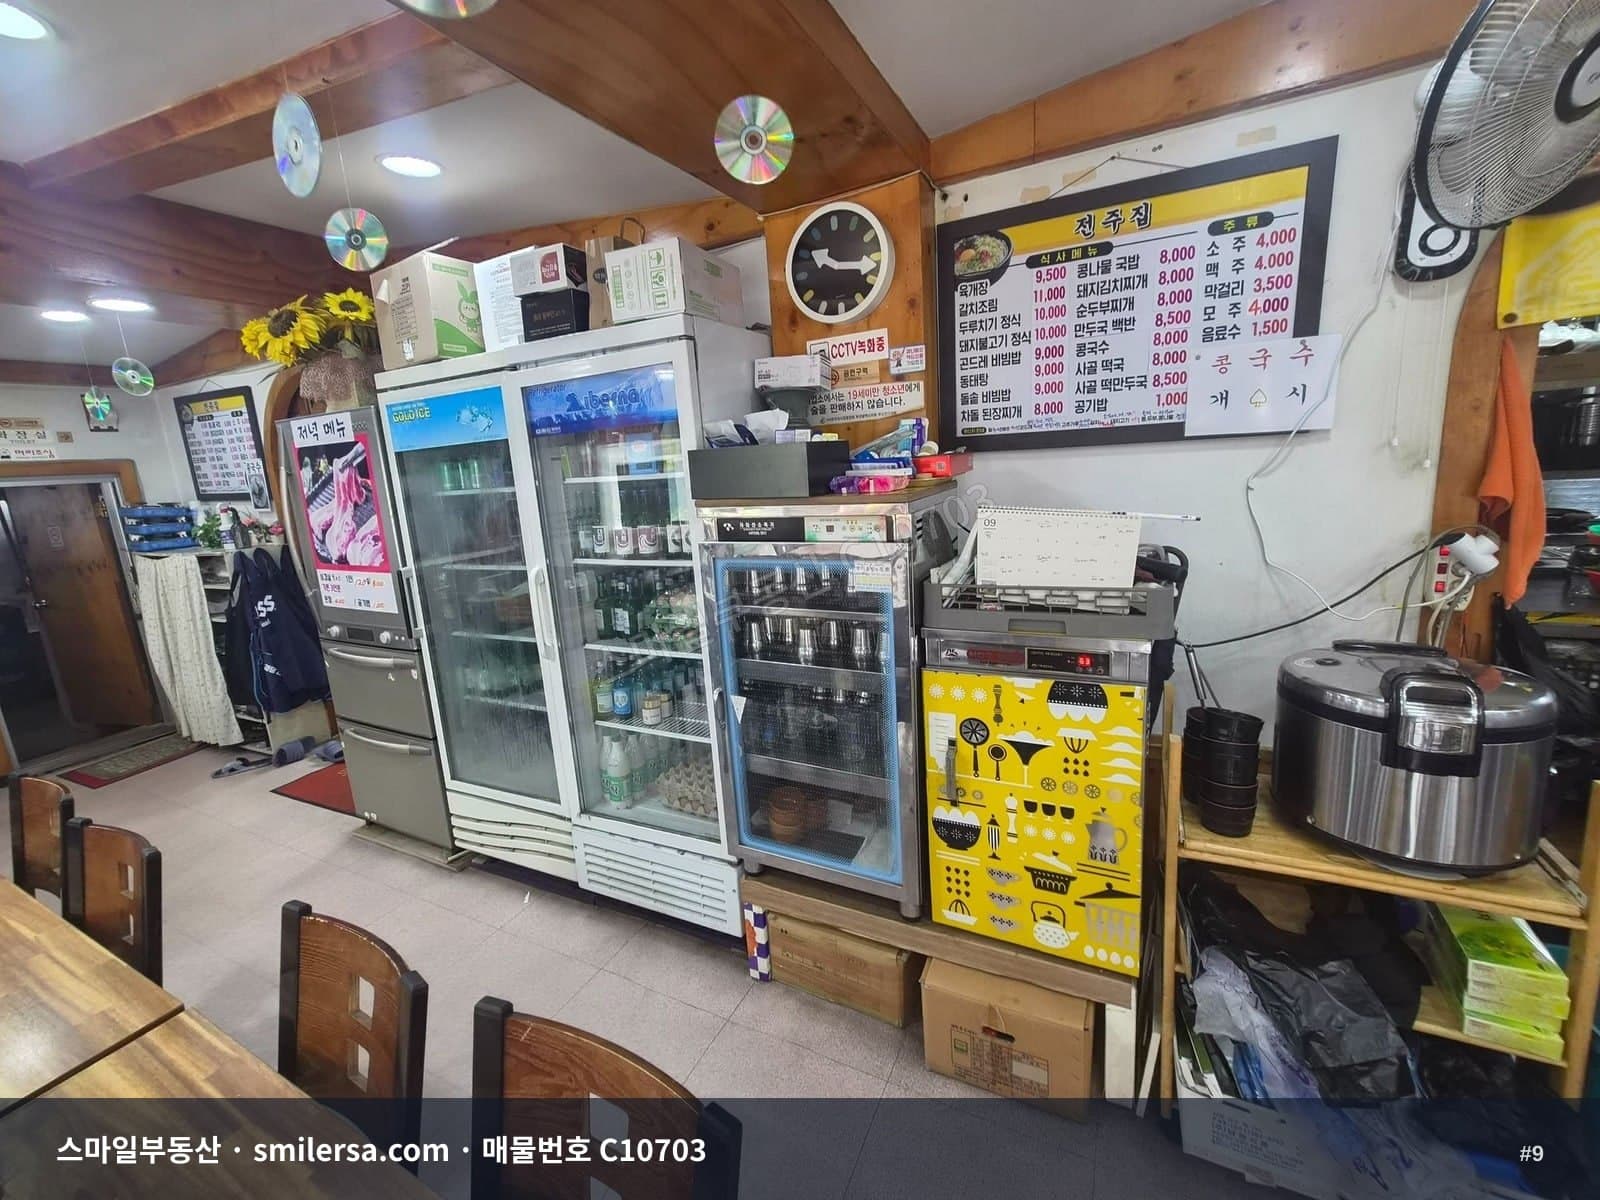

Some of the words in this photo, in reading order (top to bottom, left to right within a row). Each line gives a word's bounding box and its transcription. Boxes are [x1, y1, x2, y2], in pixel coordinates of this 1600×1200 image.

[1074, 202, 1151, 238] 전주집
[1255, 227, 1297, 249] 4,000
[1040, 246, 1098, 264] 식사메뉴
[1077, 259, 1112, 279] 콩나물
[1116, 254, 1139, 271] 국밥
[1159, 246, 1195, 264] 8,000
[959, 281, 988, 298] 육개장
[1035, 267, 1067, 284] 9,500
[1076, 273, 1148, 298] 돼지김치찌개
[1158, 267, 1194, 285] 8,000
[1204, 280, 1244, 299] 막걸리
[1253, 274, 1293, 294] 3,500
[959, 298, 998, 317] 갈치조림
[1034, 286, 1066, 303] 11,000
[1076, 296, 1135, 318] 순두부찌개
[1157, 288, 1193, 307] 8,000
[959, 317, 998, 335] 두루치기
[1000, 313, 1021, 329] 정식
[1034, 304, 1067, 320] 10,000
[1074, 320, 1108, 338] 만두국
[1111, 316, 1136, 332] 백반
[1154, 309, 1191, 327] 8,500
[959, 334, 1008, 352] 돼지불고기
[1011, 330, 1032, 346] 정식
[1034, 324, 1067, 341] 10,000
[1075, 340, 1109, 357] 콩국수
[1153, 330, 1188, 347] 8,000
[1202, 323, 1241, 343] 음료수
[831, 336, 885, 359] CCTV녹화중
[960, 355, 988, 371] 곤드레
[991, 350, 1021, 367] 비빔밥
[1034, 345, 1064, 360] 9,000
[960, 373, 989, 388] 동태탕
[1034, 362, 1064, 377] 9,000
[1075, 361, 1097, 376] 사골
[1101, 357, 1124, 372] 떡국
[1152, 350, 1187, 366] 8,000
[882, 382, 921, 397] 청소년에게
[960, 391, 979, 406] 돌솥
[981, 388, 1011, 404] 비빔밥
[1034, 381, 1064, 395] 9,000
[1075, 380, 1097, 395] 사골
[1100, 375, 1148, 393] 떡만두국
[1152, 371, 1188, 388] 8,500
[810, 404, 828, 416] 술을
[830, 399, 864, 413] 판매하지
[1074, 398, 1108, 414] 공기밥
[1156, 391, 1188, 408] 1,000
[1210, 389, 1229, 411] 개
[1286, 383, 1307, 406] 시
[960, 409, 979, 422] 차돌
[982, 405, 1022, 421] 된장찌개
[1034, 401, 1063, 416] 8,000
[297, 420, 319, 441] 저녁
[323, 418, 346, 438] 메뉴
[983, 518, 997, 527] 09
